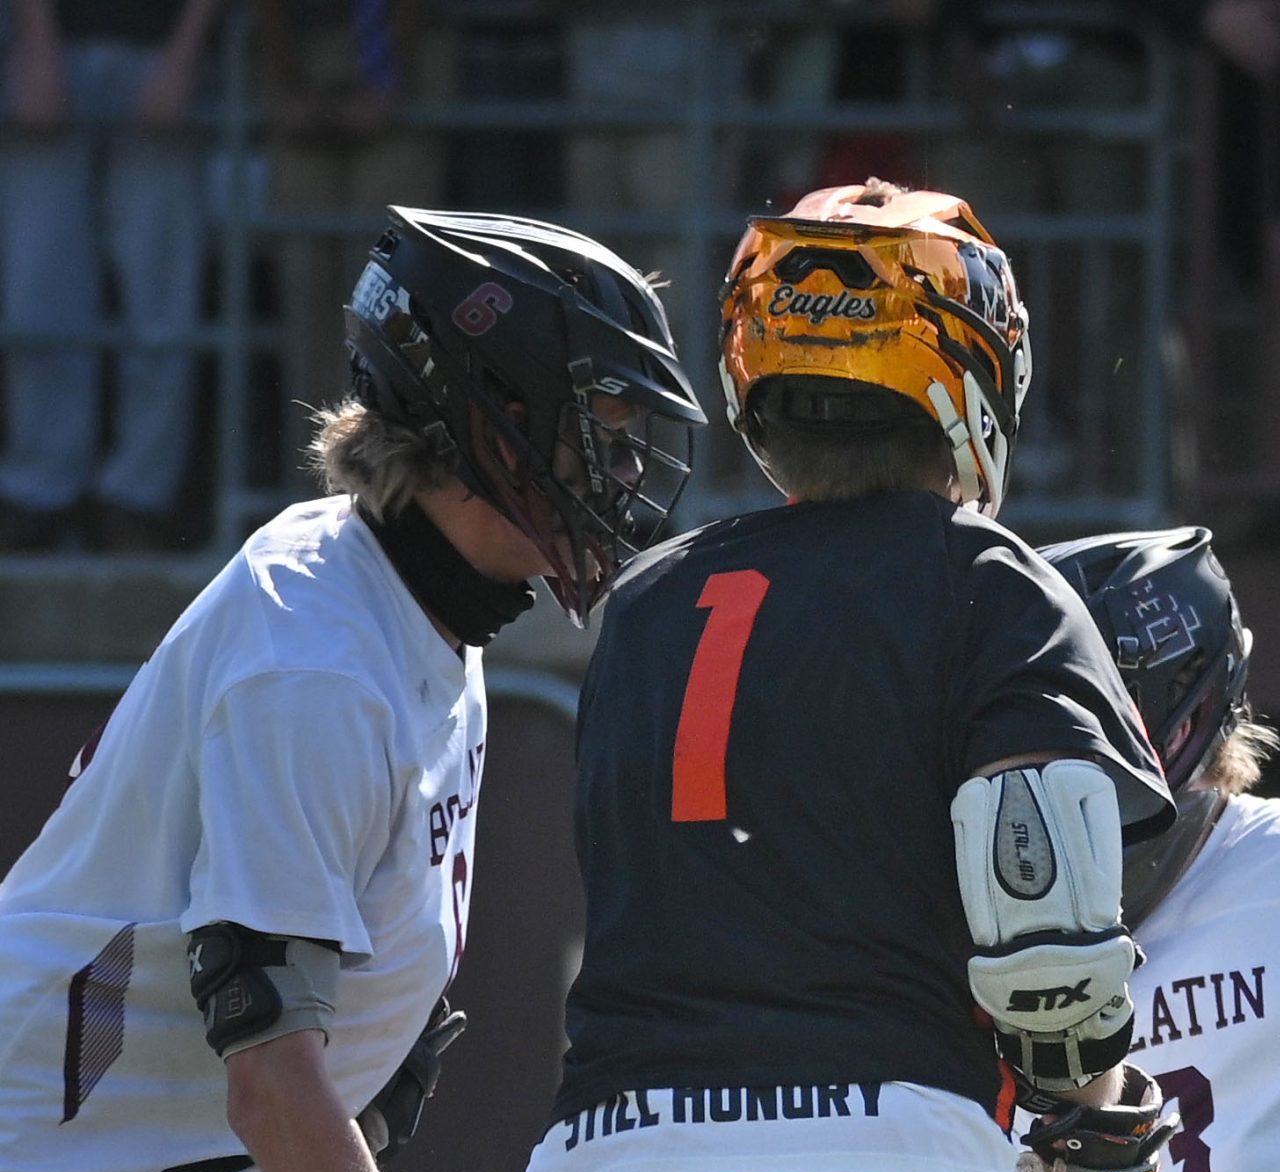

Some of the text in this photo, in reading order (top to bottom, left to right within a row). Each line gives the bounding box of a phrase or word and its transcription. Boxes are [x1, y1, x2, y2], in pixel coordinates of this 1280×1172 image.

[452, 282, 513, 336] 6
[769, 284, 876, 324] Eagles
[671, 569, 771, 821] 1
[1006, 977, 1092, 1012] STX
